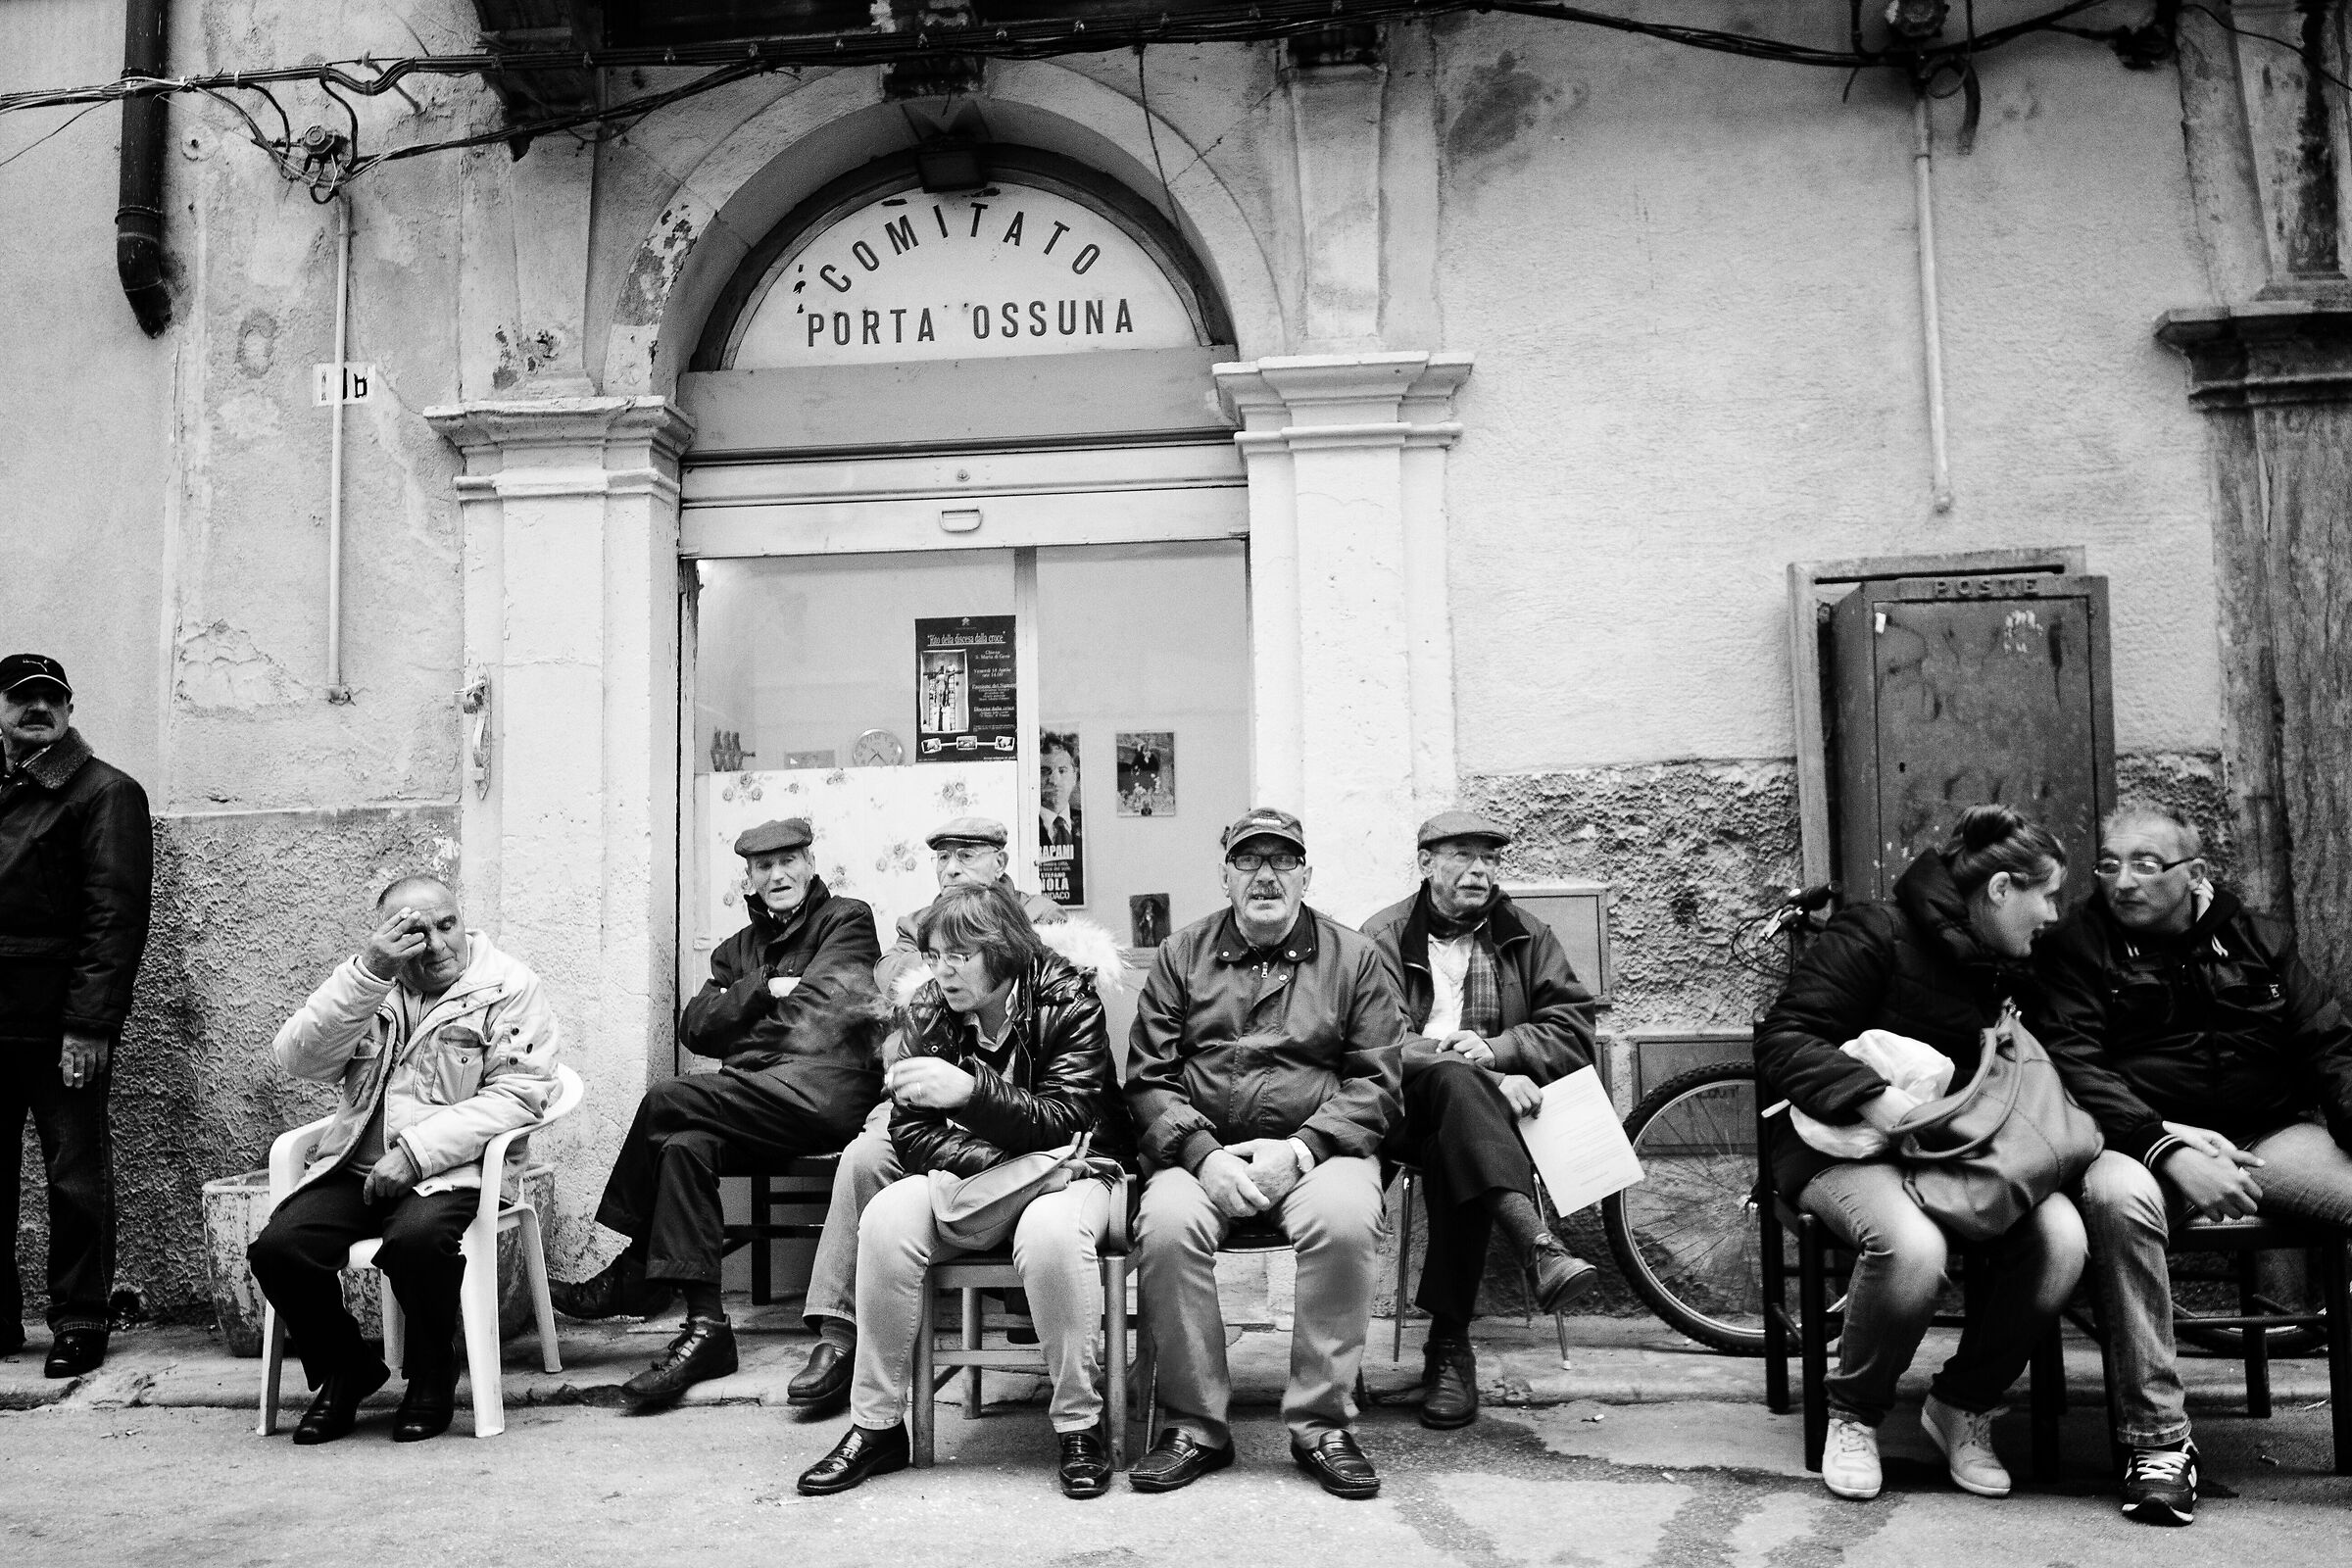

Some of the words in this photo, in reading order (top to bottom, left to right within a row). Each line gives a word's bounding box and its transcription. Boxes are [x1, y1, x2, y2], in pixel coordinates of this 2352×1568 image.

[819, 202, 1101, 293] COMITATO
[808, 308, 935, 347] PORTA
[973, 298, 1133, 340] OSSUNA
